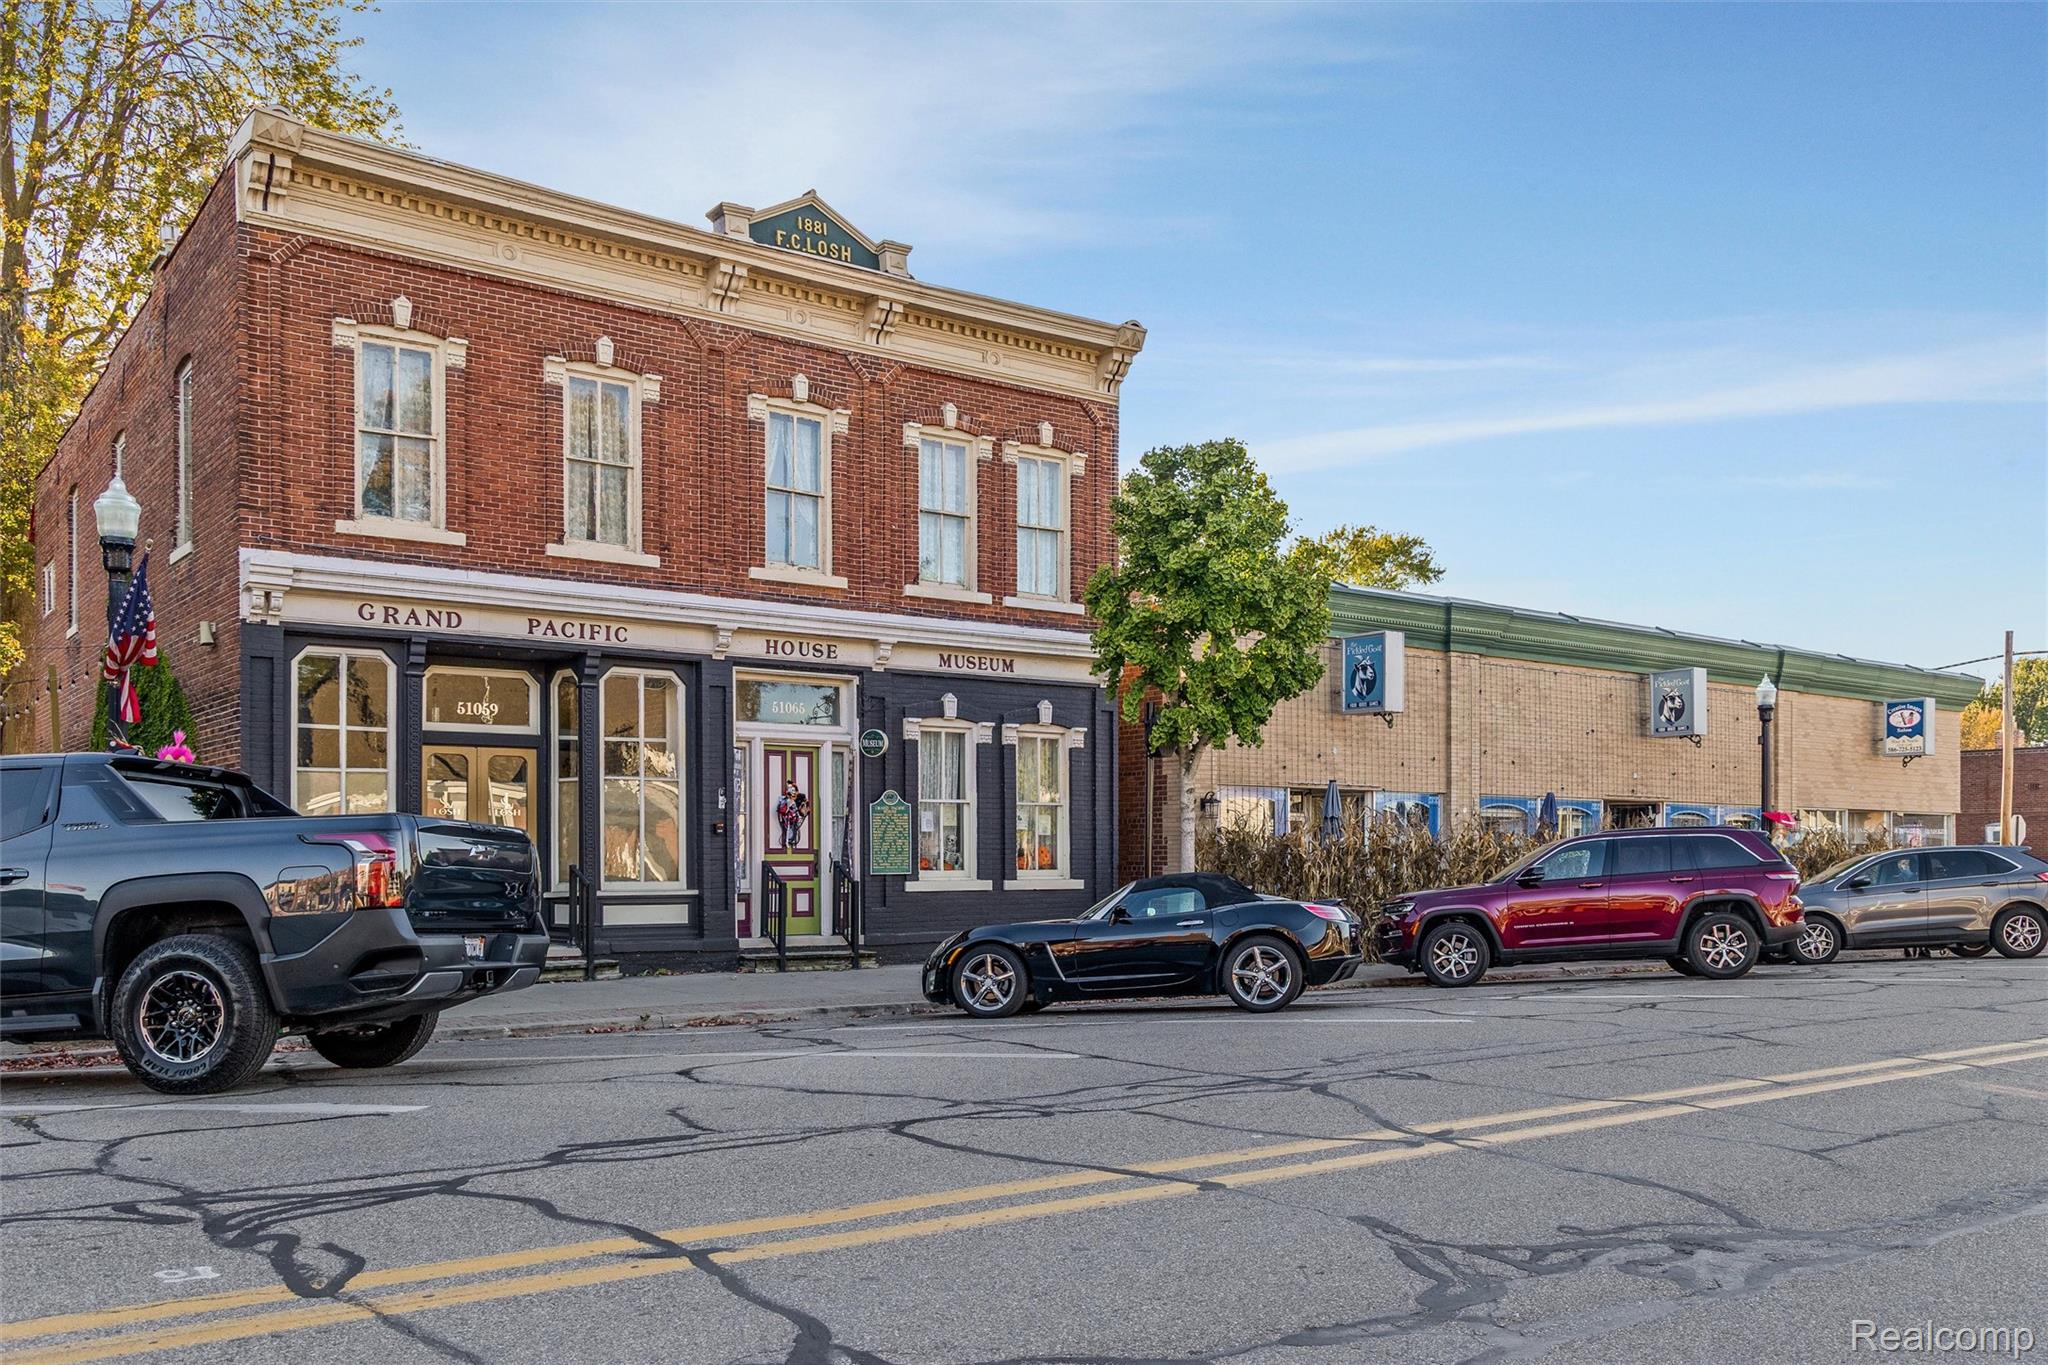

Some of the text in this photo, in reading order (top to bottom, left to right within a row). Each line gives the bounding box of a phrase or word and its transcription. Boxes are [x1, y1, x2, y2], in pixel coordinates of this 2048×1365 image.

[797, 216, 827, 236] 1881
[358, 603, 1015, 673] GRAND PACIFIC HOUSE MUSEUM
[456, 702, 499, 716] 51059
[771, 701, 805, 714] 51065
[863, 738, 884, 748] MUSEUM
